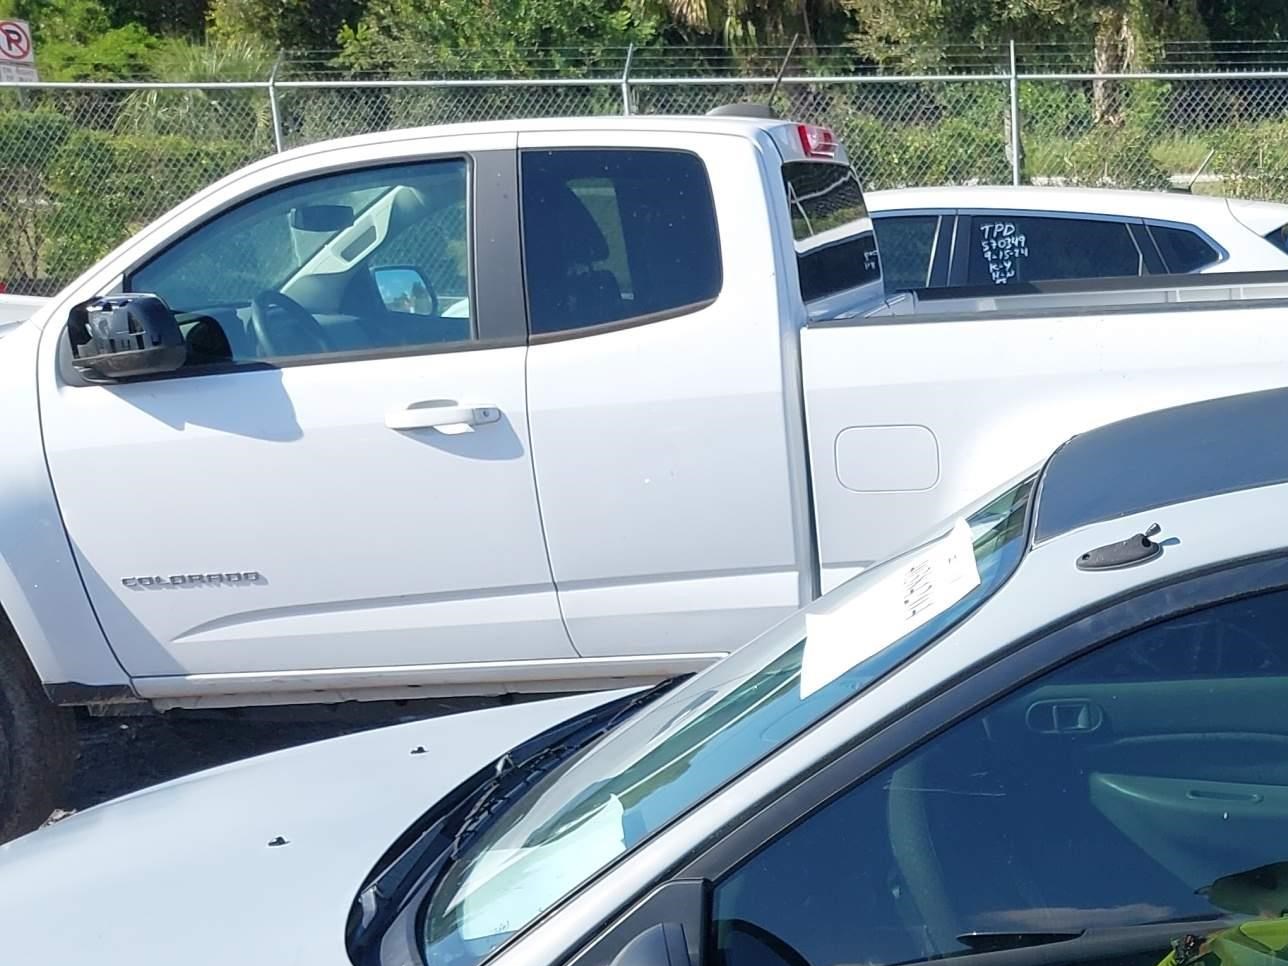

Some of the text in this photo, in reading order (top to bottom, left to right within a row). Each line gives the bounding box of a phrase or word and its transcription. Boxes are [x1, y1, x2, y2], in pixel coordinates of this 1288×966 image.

[980, 223, 1015, 239] TPD
[981, 234, 1026, 252] 570349
[121, 571, 260, 587] COLORADO
